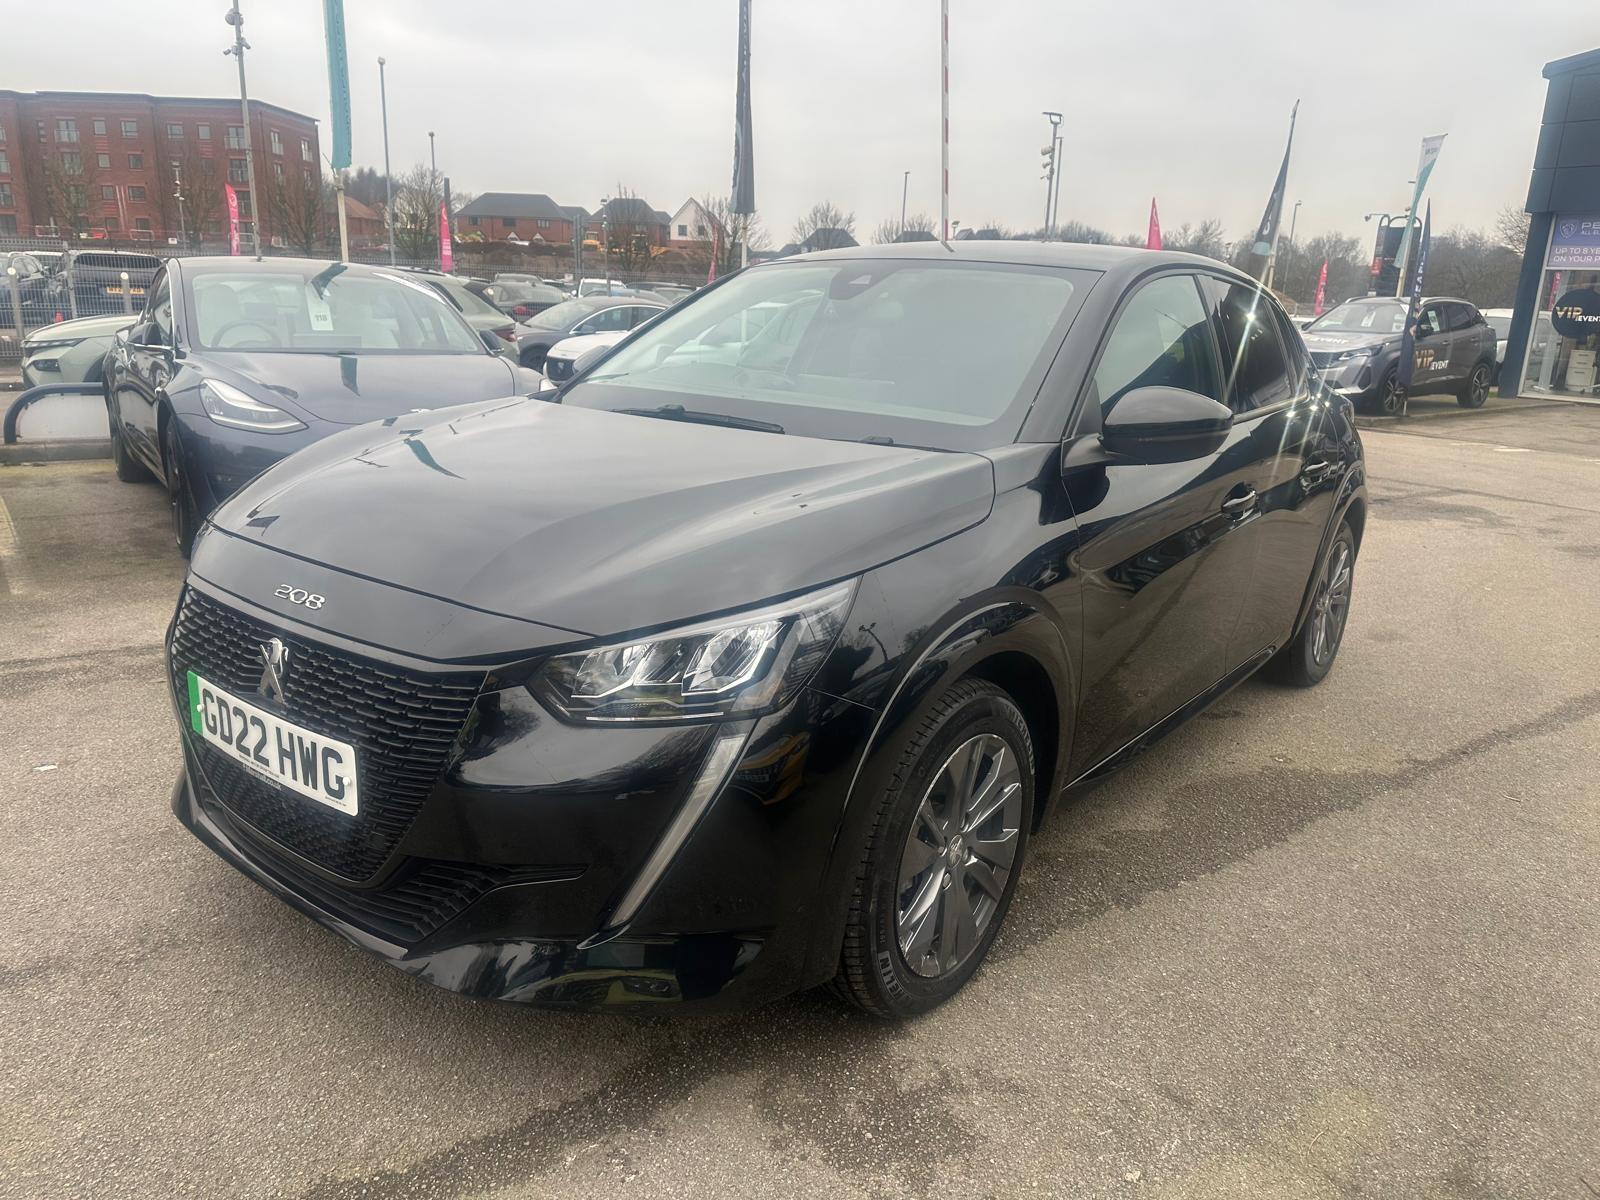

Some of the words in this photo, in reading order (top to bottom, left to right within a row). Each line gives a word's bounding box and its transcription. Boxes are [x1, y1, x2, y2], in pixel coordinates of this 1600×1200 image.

[1555, 247, 1568, 255] UP
[1569, 247, 1581, 255] TO
[1568, 255, 1593, 263] YOUR
[1555, 306, 1583, 319] VIP
[1576, 315, 1600, 323] EVEN
[1415, 349, 1435, 368] VIP
[1431, 359, 1450, 370] EVENT
[273, 583, 325, 610] 208
[202, 687, 270, 768] GD22
[275, 726, 346, 800] HWG
